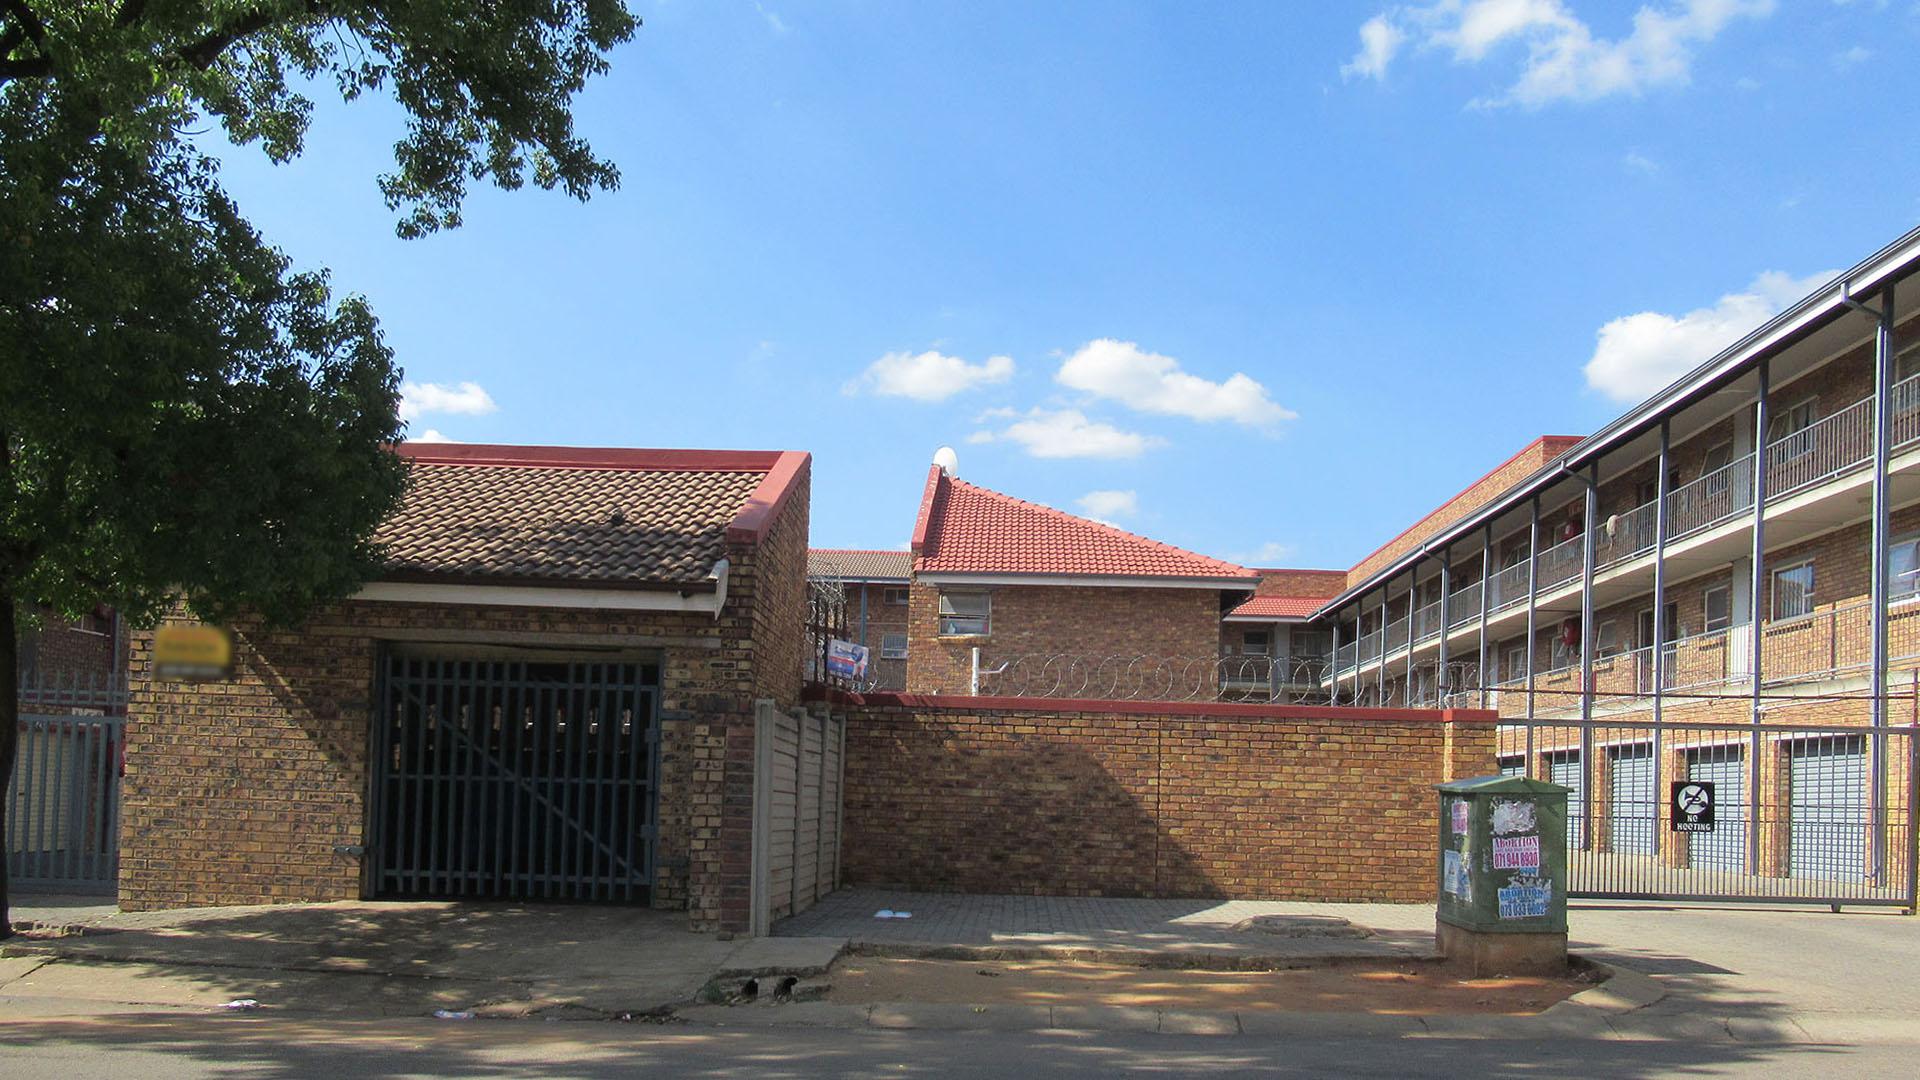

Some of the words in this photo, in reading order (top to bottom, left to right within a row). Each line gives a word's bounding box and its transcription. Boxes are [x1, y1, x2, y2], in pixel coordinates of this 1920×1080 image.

[1677, 823, 1711, 831] HOOTING
[1495, 836, 1538, 848] ABORTION
[1495, 853, 1505, 867] 071
[1507, 853, 1519, 867] 944
[1500, 887, 1543, 902] ABORTION
